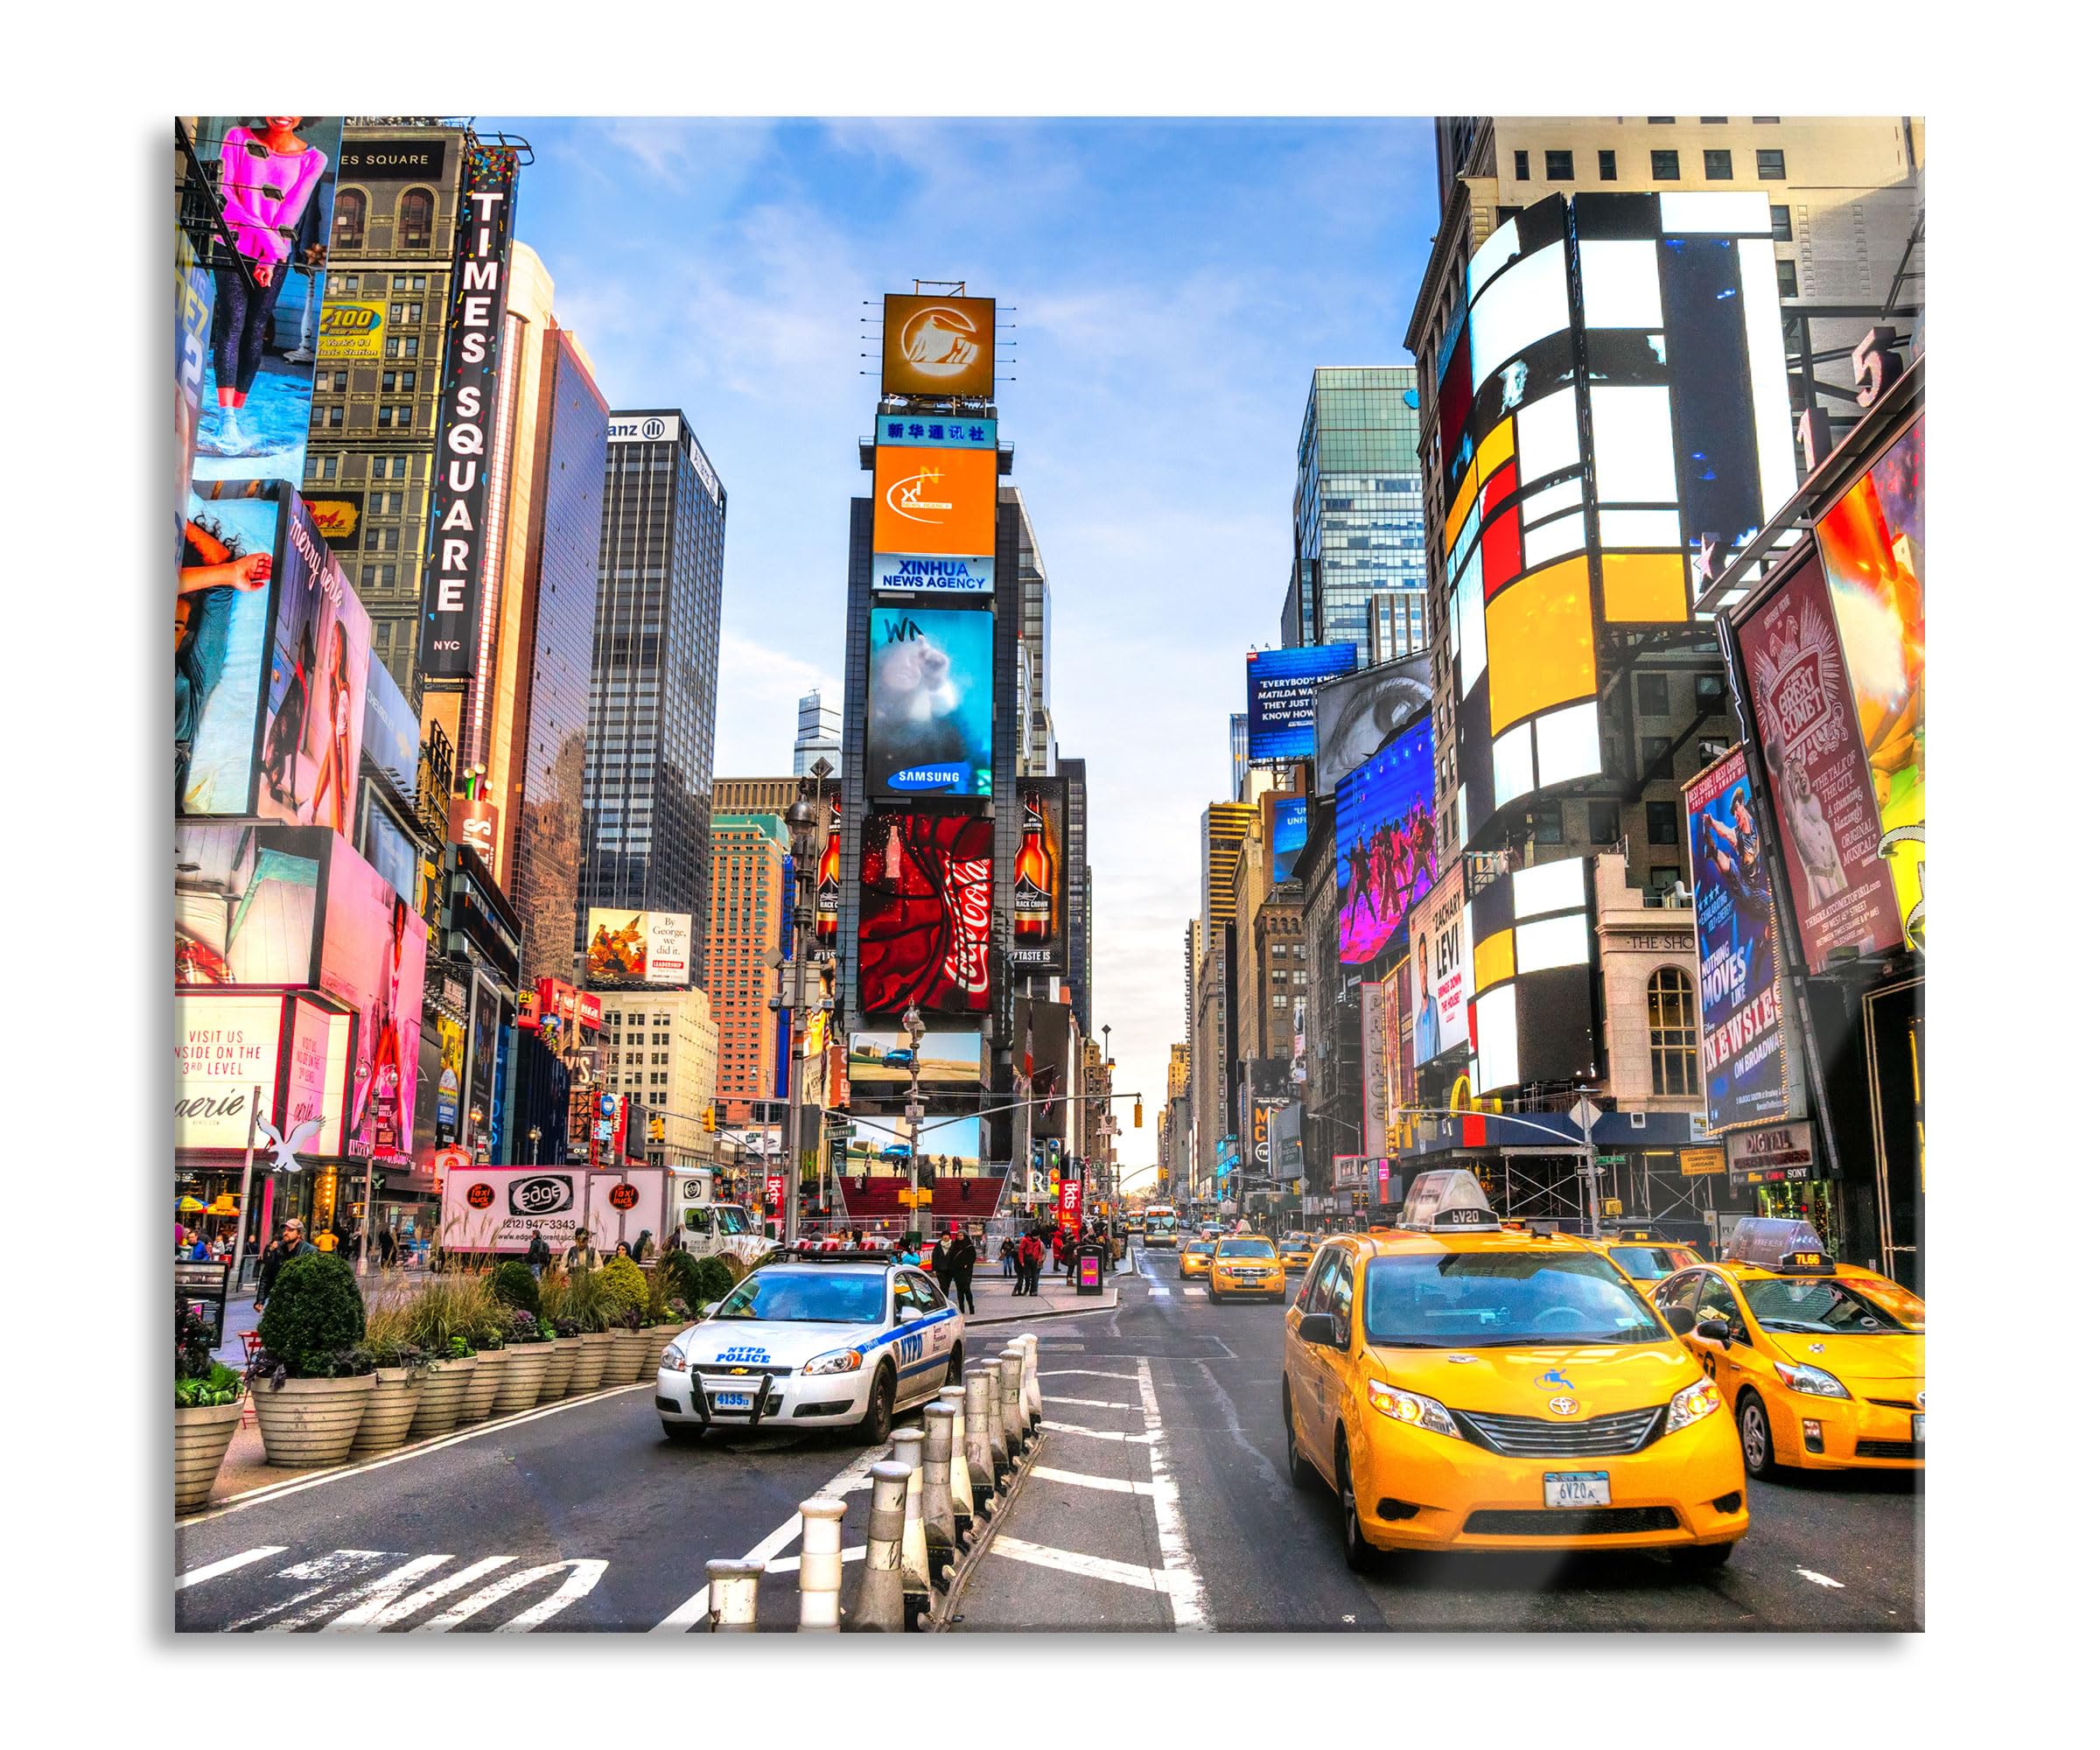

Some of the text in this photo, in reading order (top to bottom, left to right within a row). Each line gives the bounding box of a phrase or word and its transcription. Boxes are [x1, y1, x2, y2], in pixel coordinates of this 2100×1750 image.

[366, 155, 429, 166] SQUARE
[461, 192, 504, 364] TIMES
[887, 423, 985, 442] 新华通讯社
[438, 387, 483, 612] SQUARE
[898, 559, 970, 578] XINHUA
[883, 575, 985, 589] NEWS AGENCY
[433, 640, 461, 650] NYC
[1257, 690, 1297, 699] MATILDA
[1263, 701, 1287, 710] THEY
[1262, 711, 1291, 720] KNOW
[899, 771, 960, 782] SAMSUNG
[1841, 818, 1875, 849] ORIGINAL
[664, 917, 676, 928] By
[656, 945, 670, 955] did
[1436, 921, 1460, 980] LEVI
[1701, 940, 1731, 978] NOTHING
[1702, 946, 1746, 1013] MOVES
[1732, 980, 1746, 1008] LIKE
[189, 1030, 243, 1043] VISIT US
[216, 1046, 233, 1059] ON
[239, 1046, 262, 1060] THE
[1369, 994, 1385, 1120] PALACE
[182, 1061, 244, 1075] 3RD LEVEL
[1734, 1057, 1745, 1080] ON
[174, 1088, 246, 1119] aerie
[1788, 1169, 1807, 1179] SONY
[521, 1185, 562, 1205] edge
[1064, 1182, 1079, 1209] tkts
[502, 1218, 576, 1229] (212) 947-3343
[1795, 1253, 1821, 1265] 7L66
[900, 1333, 923, 1367] NYPD
[714, 1354, 771, 1363] POLICE
